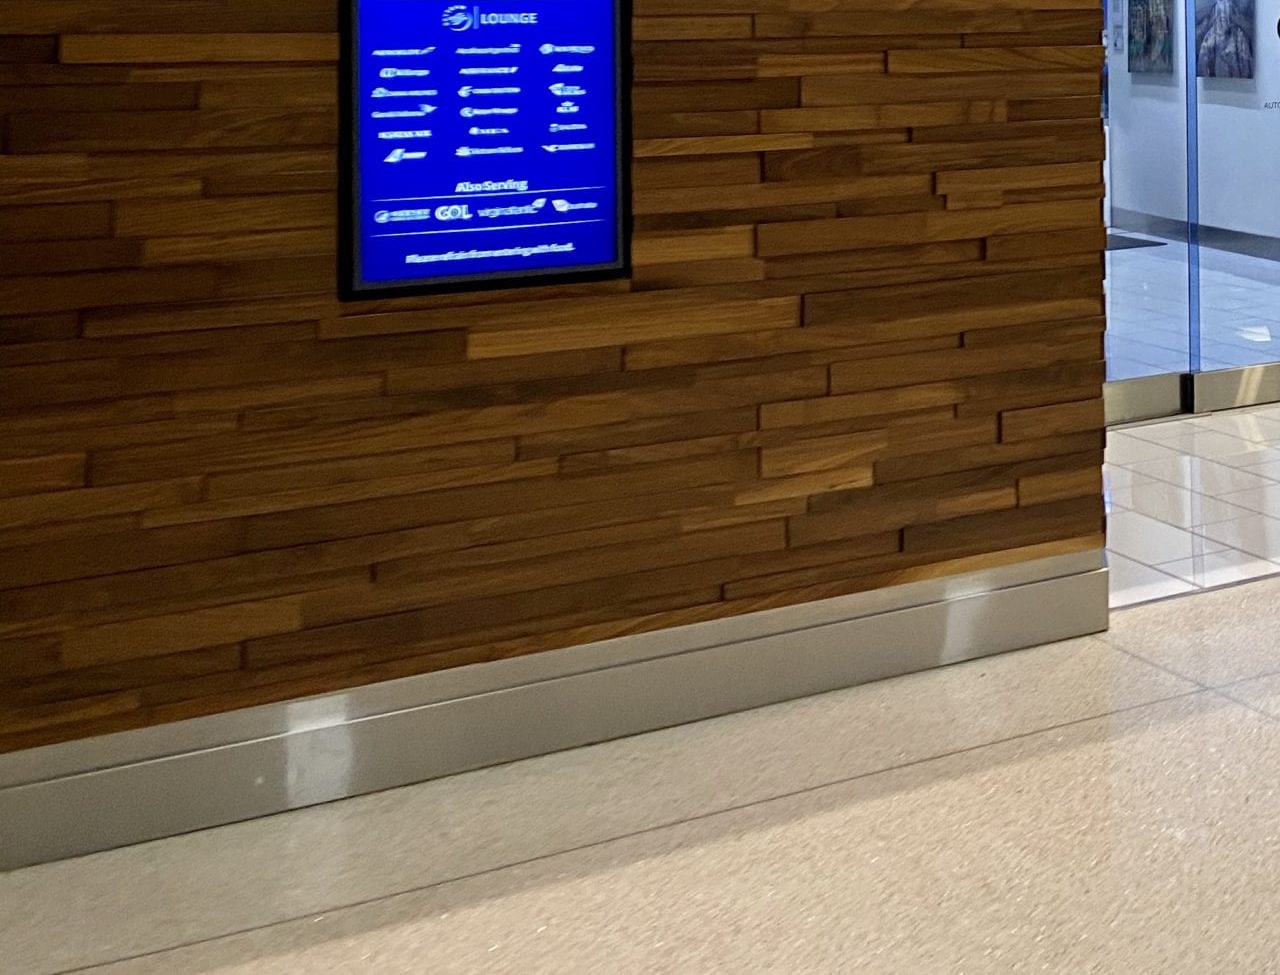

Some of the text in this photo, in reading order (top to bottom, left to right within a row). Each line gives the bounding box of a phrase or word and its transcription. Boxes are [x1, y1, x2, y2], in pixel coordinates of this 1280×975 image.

[480, 13, 539, 24] LOUNGE
[455, 179, 528, 193] Also Serving
